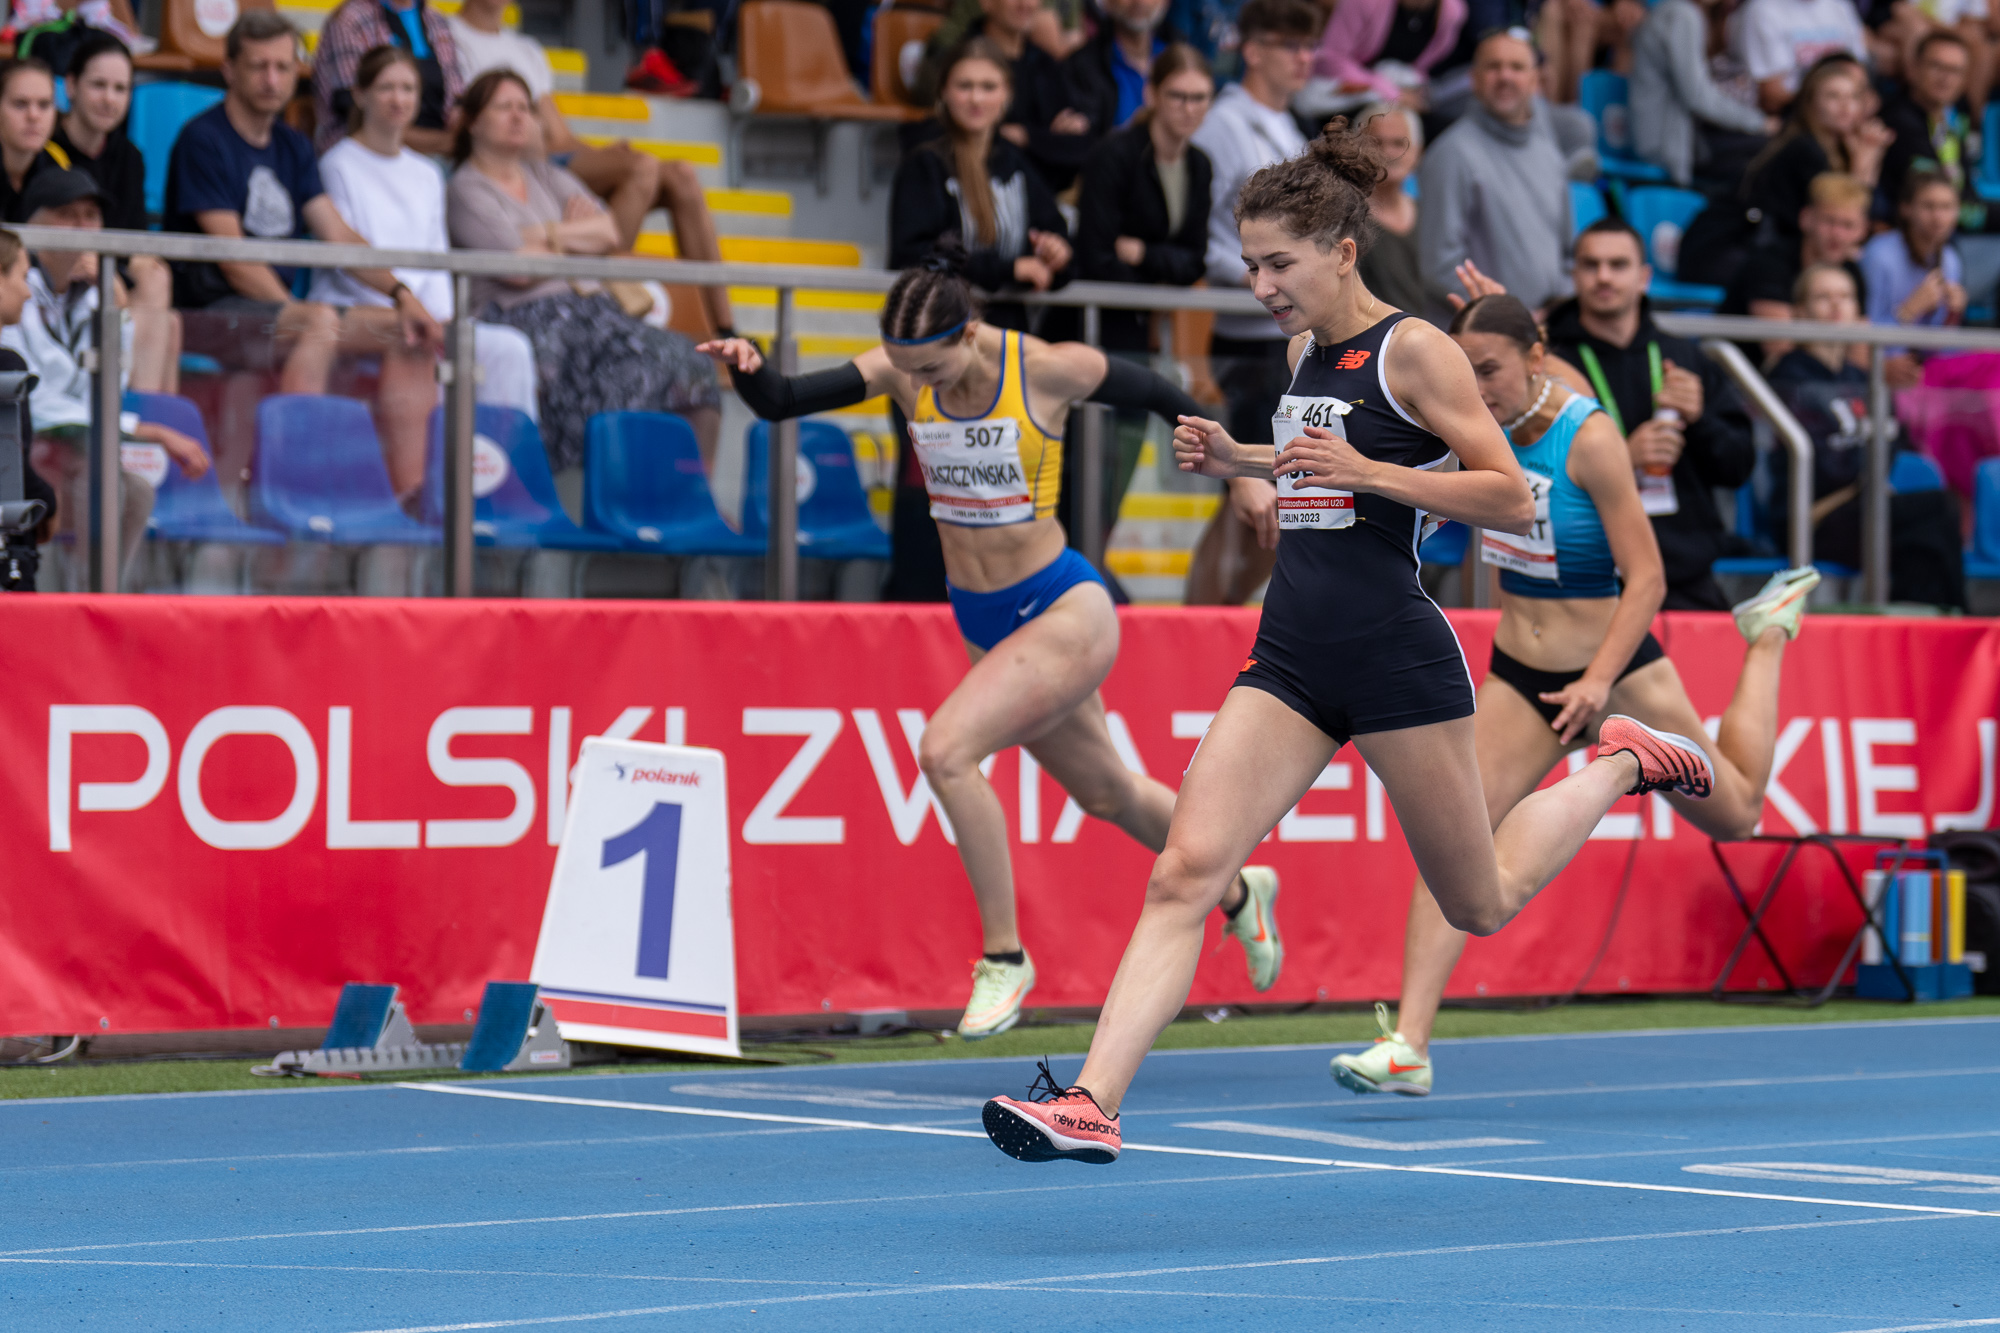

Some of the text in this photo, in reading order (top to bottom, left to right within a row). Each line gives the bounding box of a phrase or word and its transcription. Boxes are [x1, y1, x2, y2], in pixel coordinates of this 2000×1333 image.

[1301, 403, 1334, 427] 461
[965, 427, 1004, 447] 507
[921, 462, 1020, 487] ASZCZYŃSKA
[952, 509, 977, 518] LUBLIN
[1310, 499, 1329, 507] Polski
[1330, 499, 1344, 507] U20
[1280, 513, 1320, 523] LUBLIN 2023
[48, 704, 685, 852] POLSK
[632, 767, 700, 786] polanik
[600, 801, 683, 981] 1
[1054, 1113, 1121, 1137] new balanc
